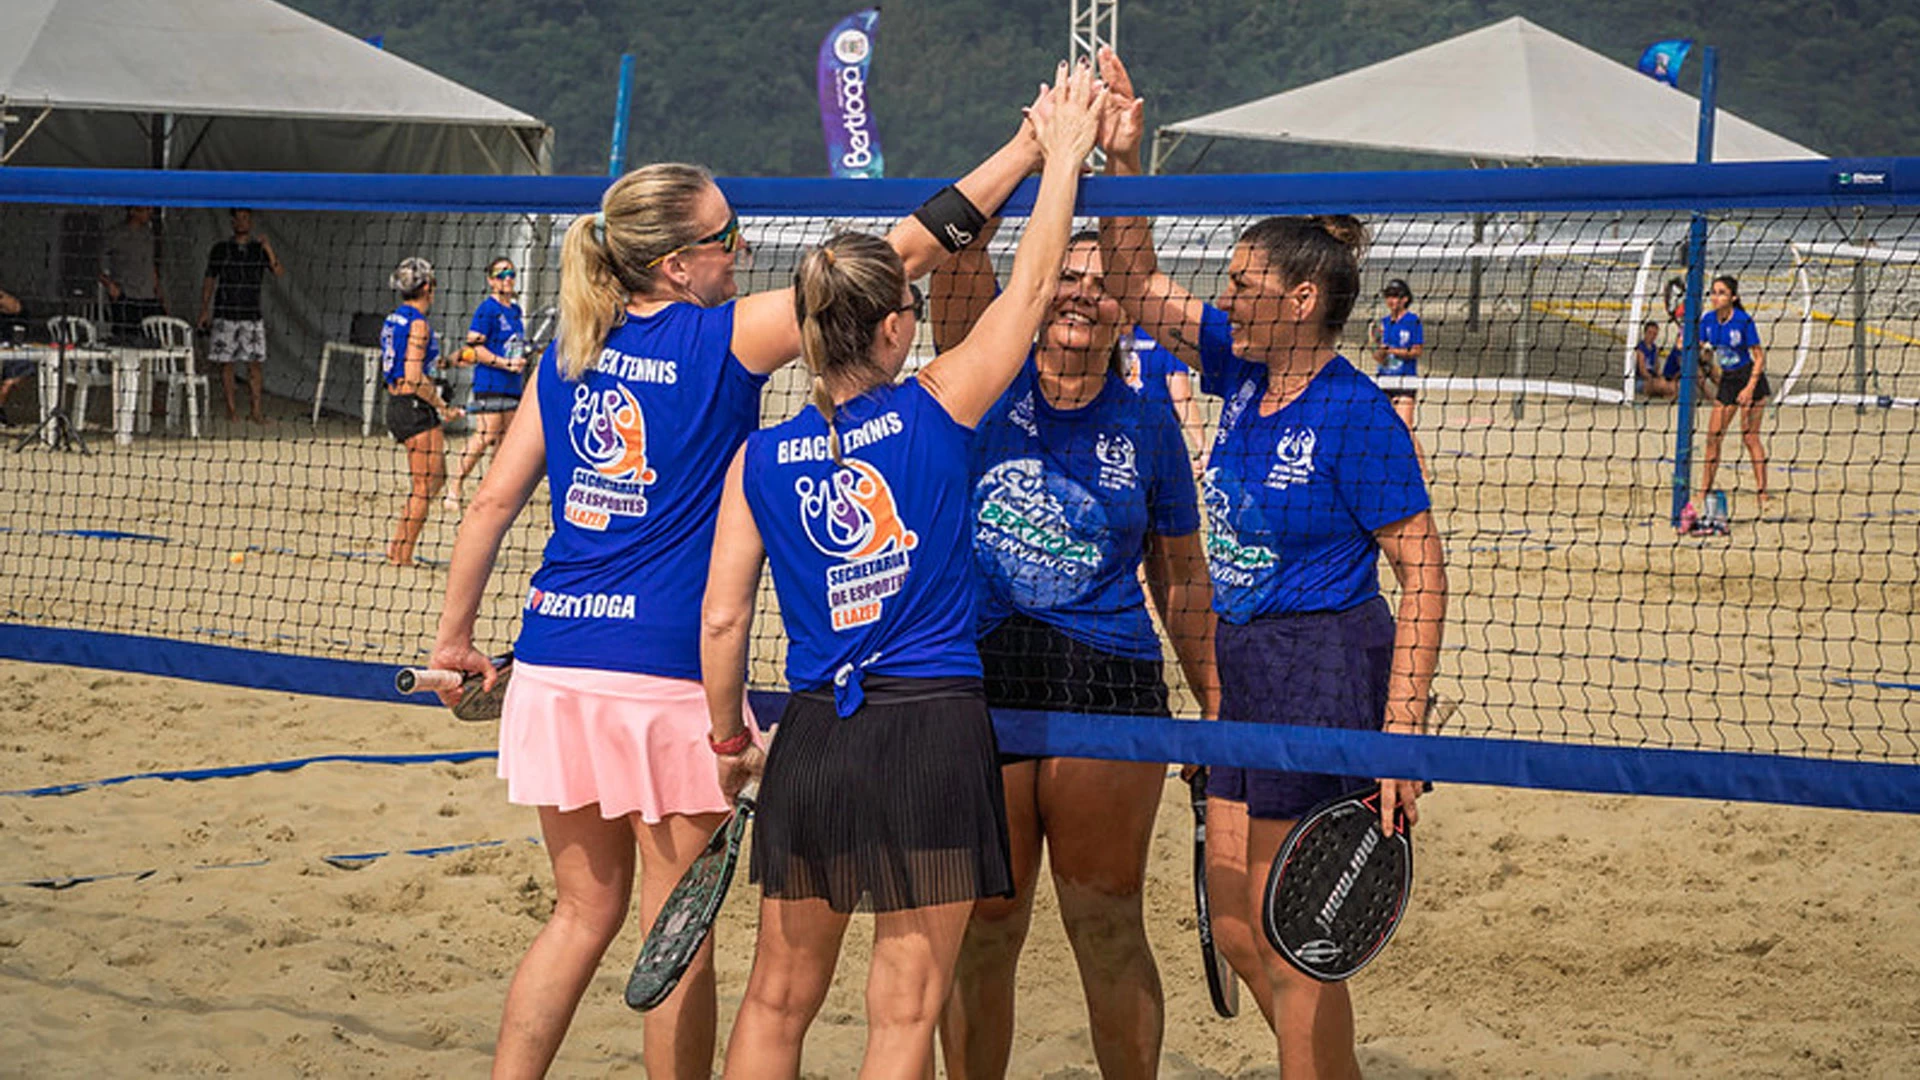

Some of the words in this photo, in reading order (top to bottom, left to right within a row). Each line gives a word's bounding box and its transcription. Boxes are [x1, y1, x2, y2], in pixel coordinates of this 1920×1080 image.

[619, 354, 677, 385] TENNIS
[830, 552, 906, 586] SECRETARIA
[832, 590, 848, 607] DE
[834, 611, 841, 628] E
